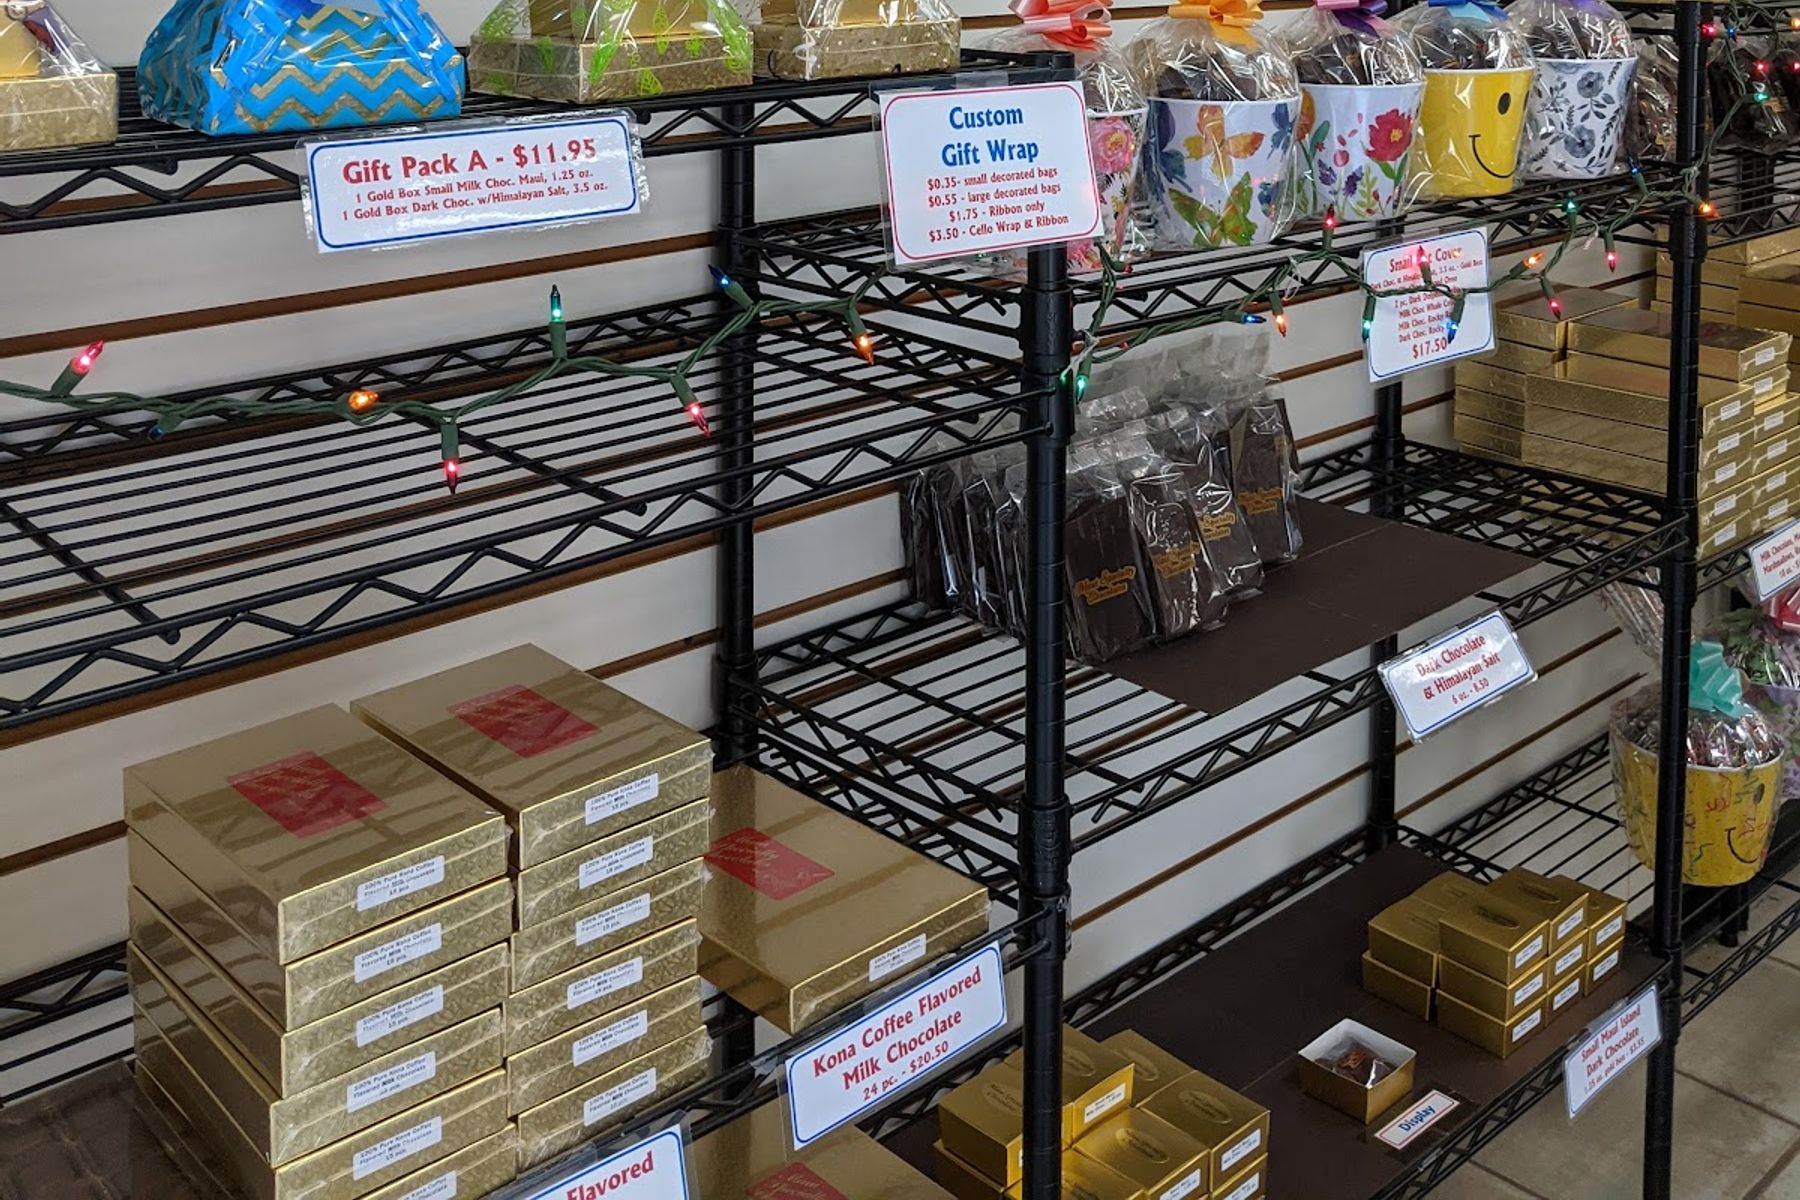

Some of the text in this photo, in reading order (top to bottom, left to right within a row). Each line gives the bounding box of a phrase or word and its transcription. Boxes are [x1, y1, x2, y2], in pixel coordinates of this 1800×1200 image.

[949, 106, 1024, 130] Custom
[343, 159, 392, 185] Gift
[401, 153, 458, 178] Pack
[467, 150, 488, 171] A
[512, 138, 597, 168] $11.95
[941, 138, 1039, 167] Gift Wrap
[356, 168, 593, 204] 1 Gold Box Small Milk Choc. Maui, 1.25 oz.
[964, 173, 988, 187] small
[990, 169, 1035, 184] decorated
[1037, 166, 1058, 181] bags
[342, 181, 609, 221] 1 Gold Box Dark Choc. w/Himalayan Salt, 3.5 oz.
[928, 182, 1062, 208] $0.55 large decorated bags
[949, 200, 1046, 223] $1.75 Ribbon only
[928, 213, 1069, 244] $3.50 Cello Wrap & Ribbon
[1413, 336, 1447, 359] $17.50
[1416, 634, 1486, 677] Dark Chocolate
[1424, 652, 1501, 700] & Himalayan Salt
[812, 966, 982, 1078] Kona Coffee Flavored
[842, 1010, 962, 1090] Milk Chocolate
[1581, 1038, 1599, 1062] Small
[1587, 1056, 1603, 1077] Dark
[1605, 1027, 1639, 1059] Chocolate
[863, 1040, 950, 1101] 24 pc. $20.50
[1398, 1105, 1436, 1132] Display
[566, 1151, 655, 1200] Flavored
